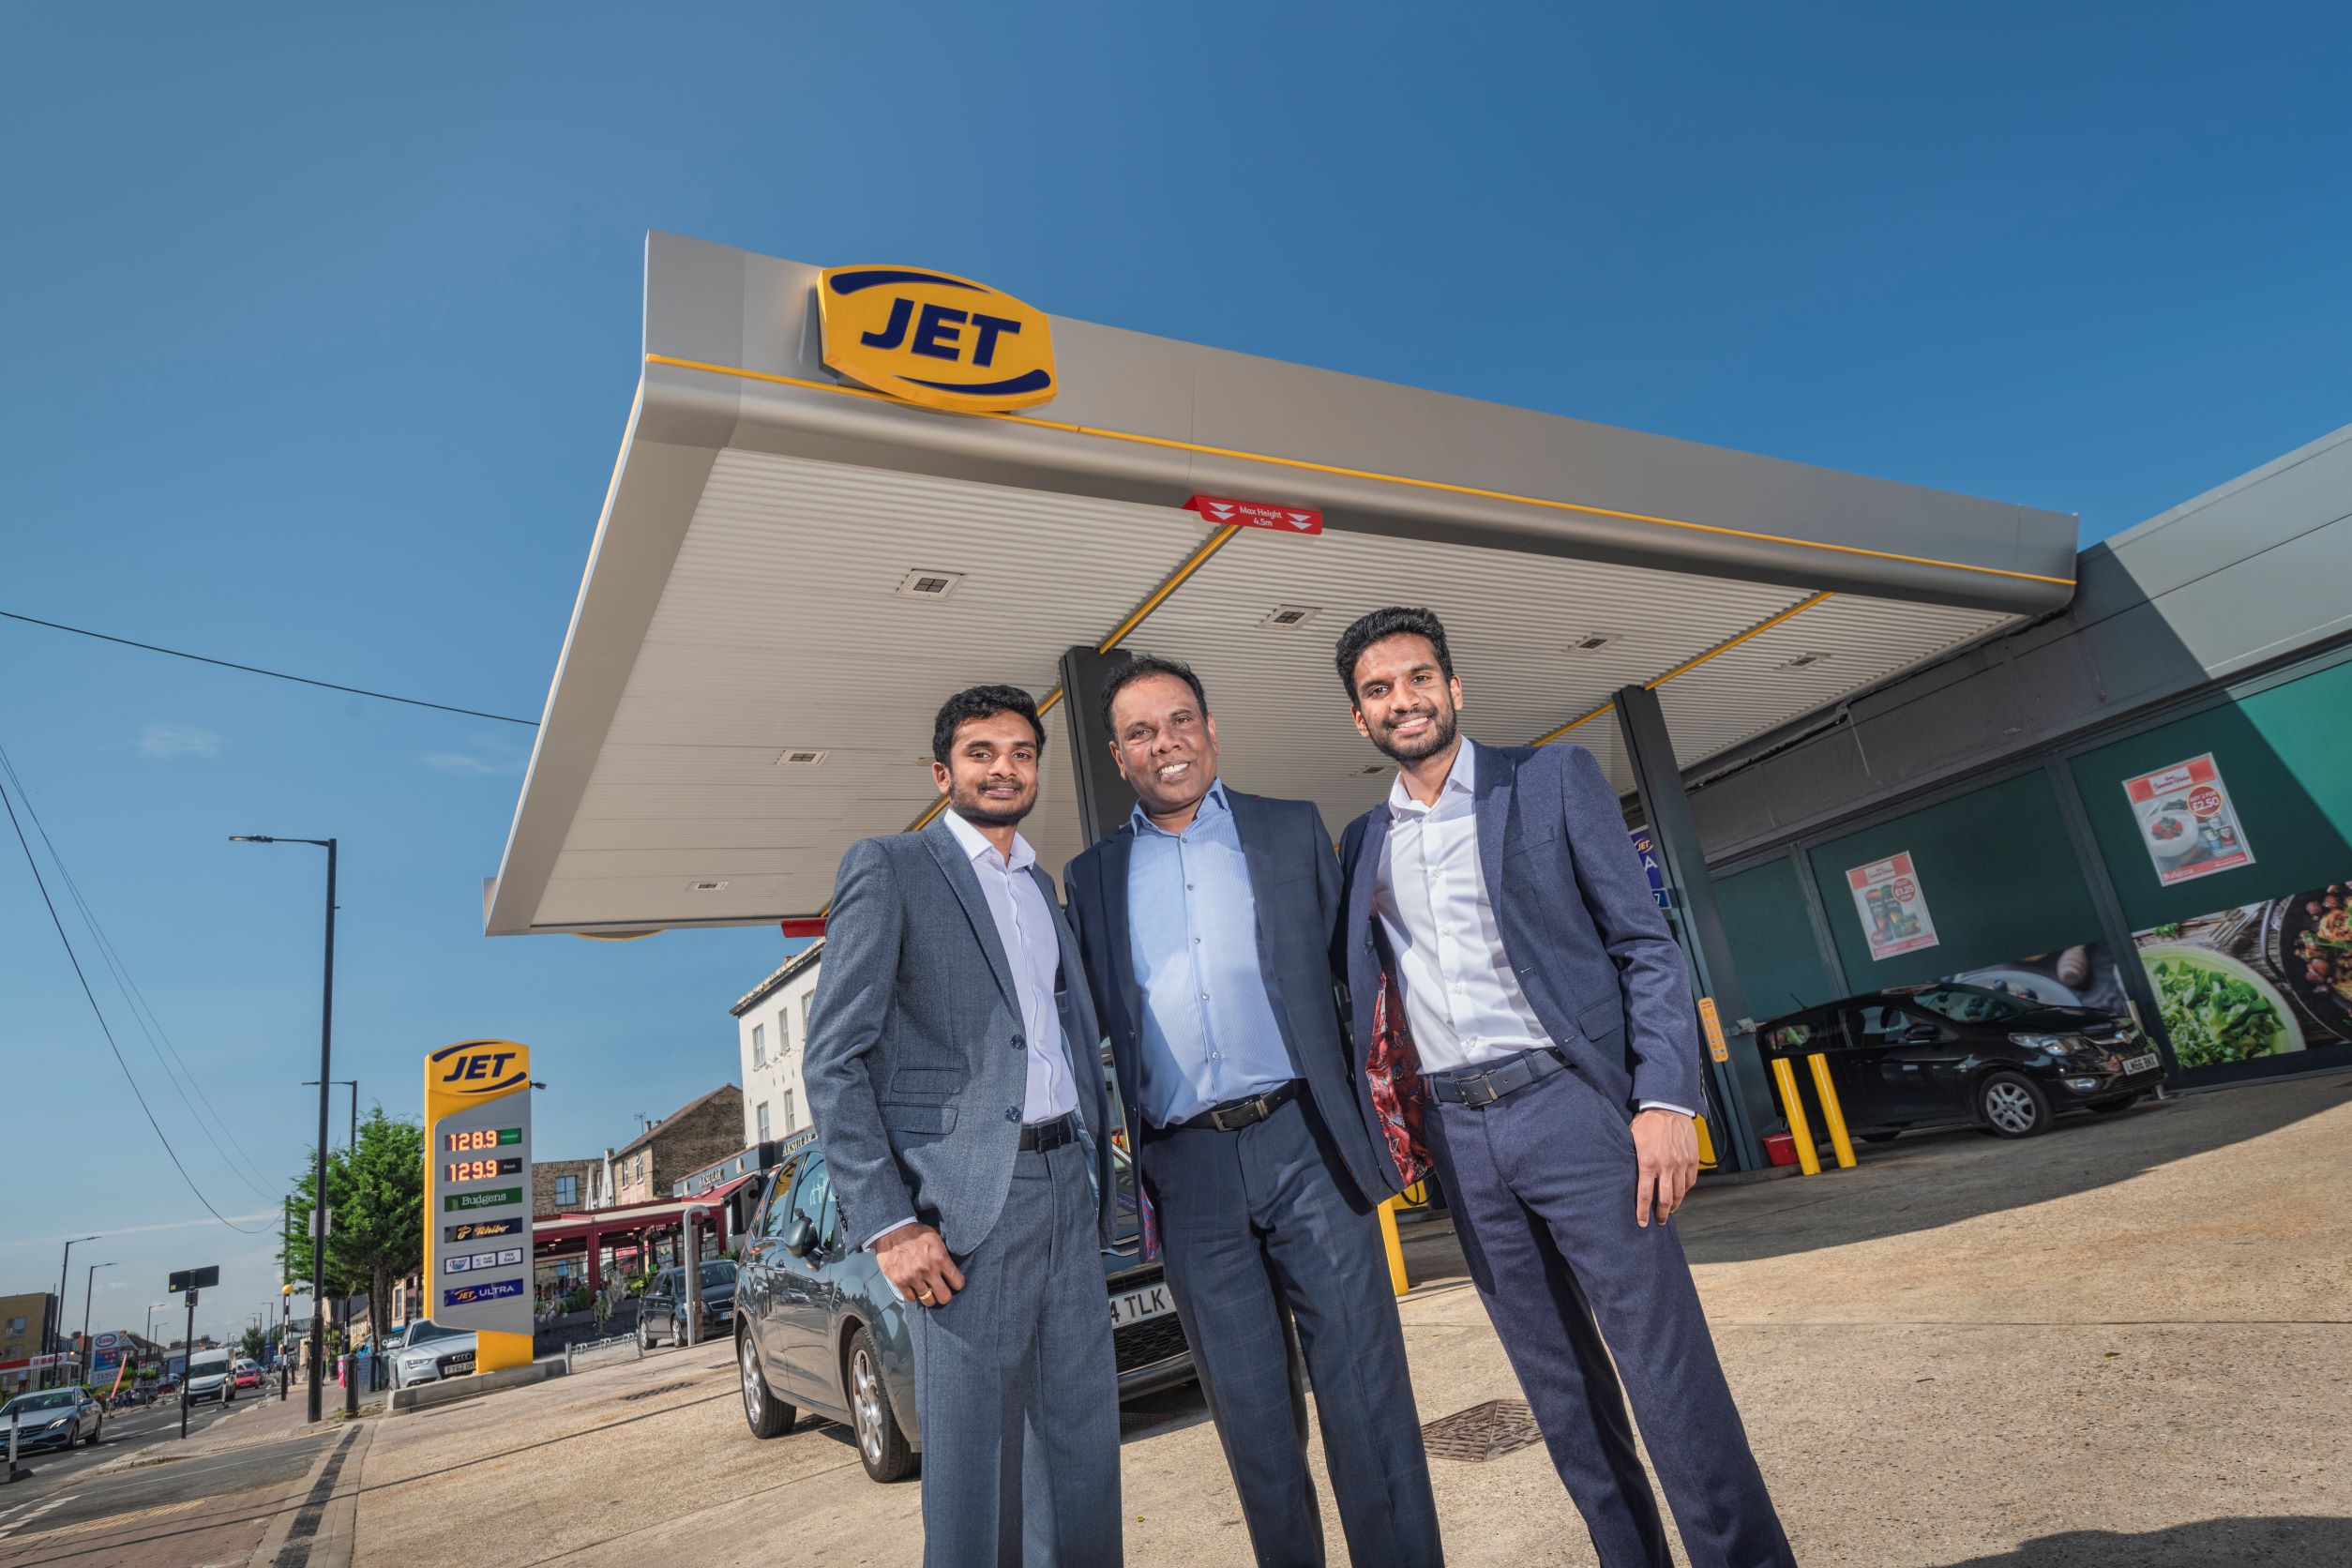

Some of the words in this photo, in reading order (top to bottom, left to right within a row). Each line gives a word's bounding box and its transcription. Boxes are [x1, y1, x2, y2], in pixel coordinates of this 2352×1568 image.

[860, 297, 1022, 368] JET
[1239, 505, 1257, 515] Max
[1258, 508, 1283, 520] Height
[1253, 517, 1274, 527] 4.5m
[2193, 796, 2220, 811] £2.50
[1637, 839, 1651, 852] JET
[443, 1052, 517, 1082] JET
[450, 1130, 497, 1152] 128.9
[450, 1159, 497, 1183] 129.9
[461, 1193, 507, 1206] Budgens
[474, 1225, 509, 1236] Tchibo
[457, 1290, 475, 1301] JET
[479, 1286, 514, 1296] ULTRA
[1124, 1289, 1166, 1319] TLK
[446, 1364, 464, 1374] FY62
